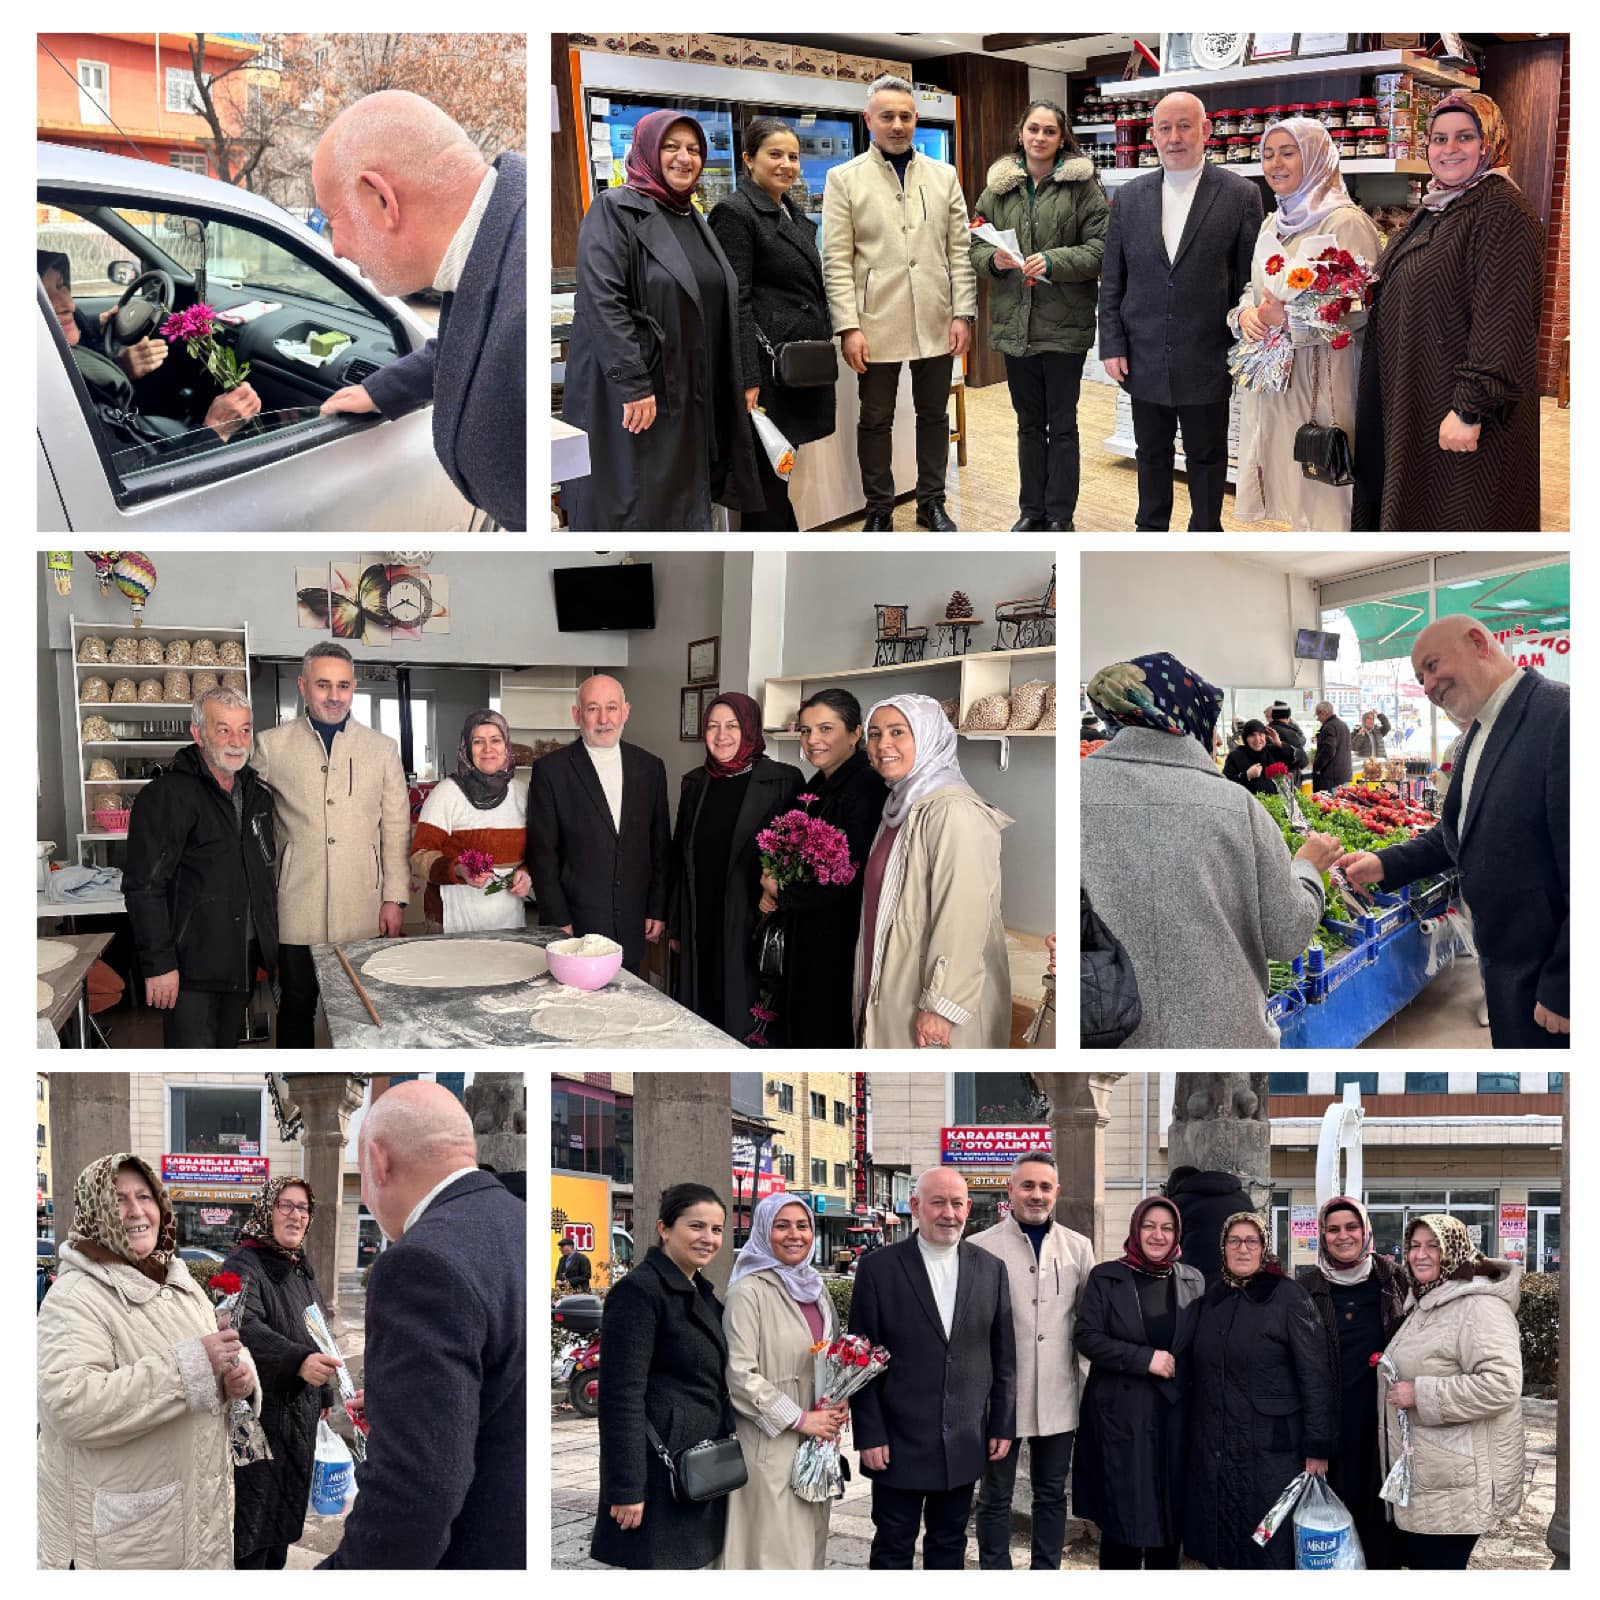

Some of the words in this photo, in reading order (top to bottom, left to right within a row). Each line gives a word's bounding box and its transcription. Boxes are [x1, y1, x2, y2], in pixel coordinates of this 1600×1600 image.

[946, 1130, 1040, 1140] KARAARSLAN
[965, 1141, 993, 1149] OTO
[995, 1141, 1027, 1149] ALIM
[166, 1157, 230, 1166] KARAARSLAN
[973, 1176, 1010, 1185] İSTİKLA
